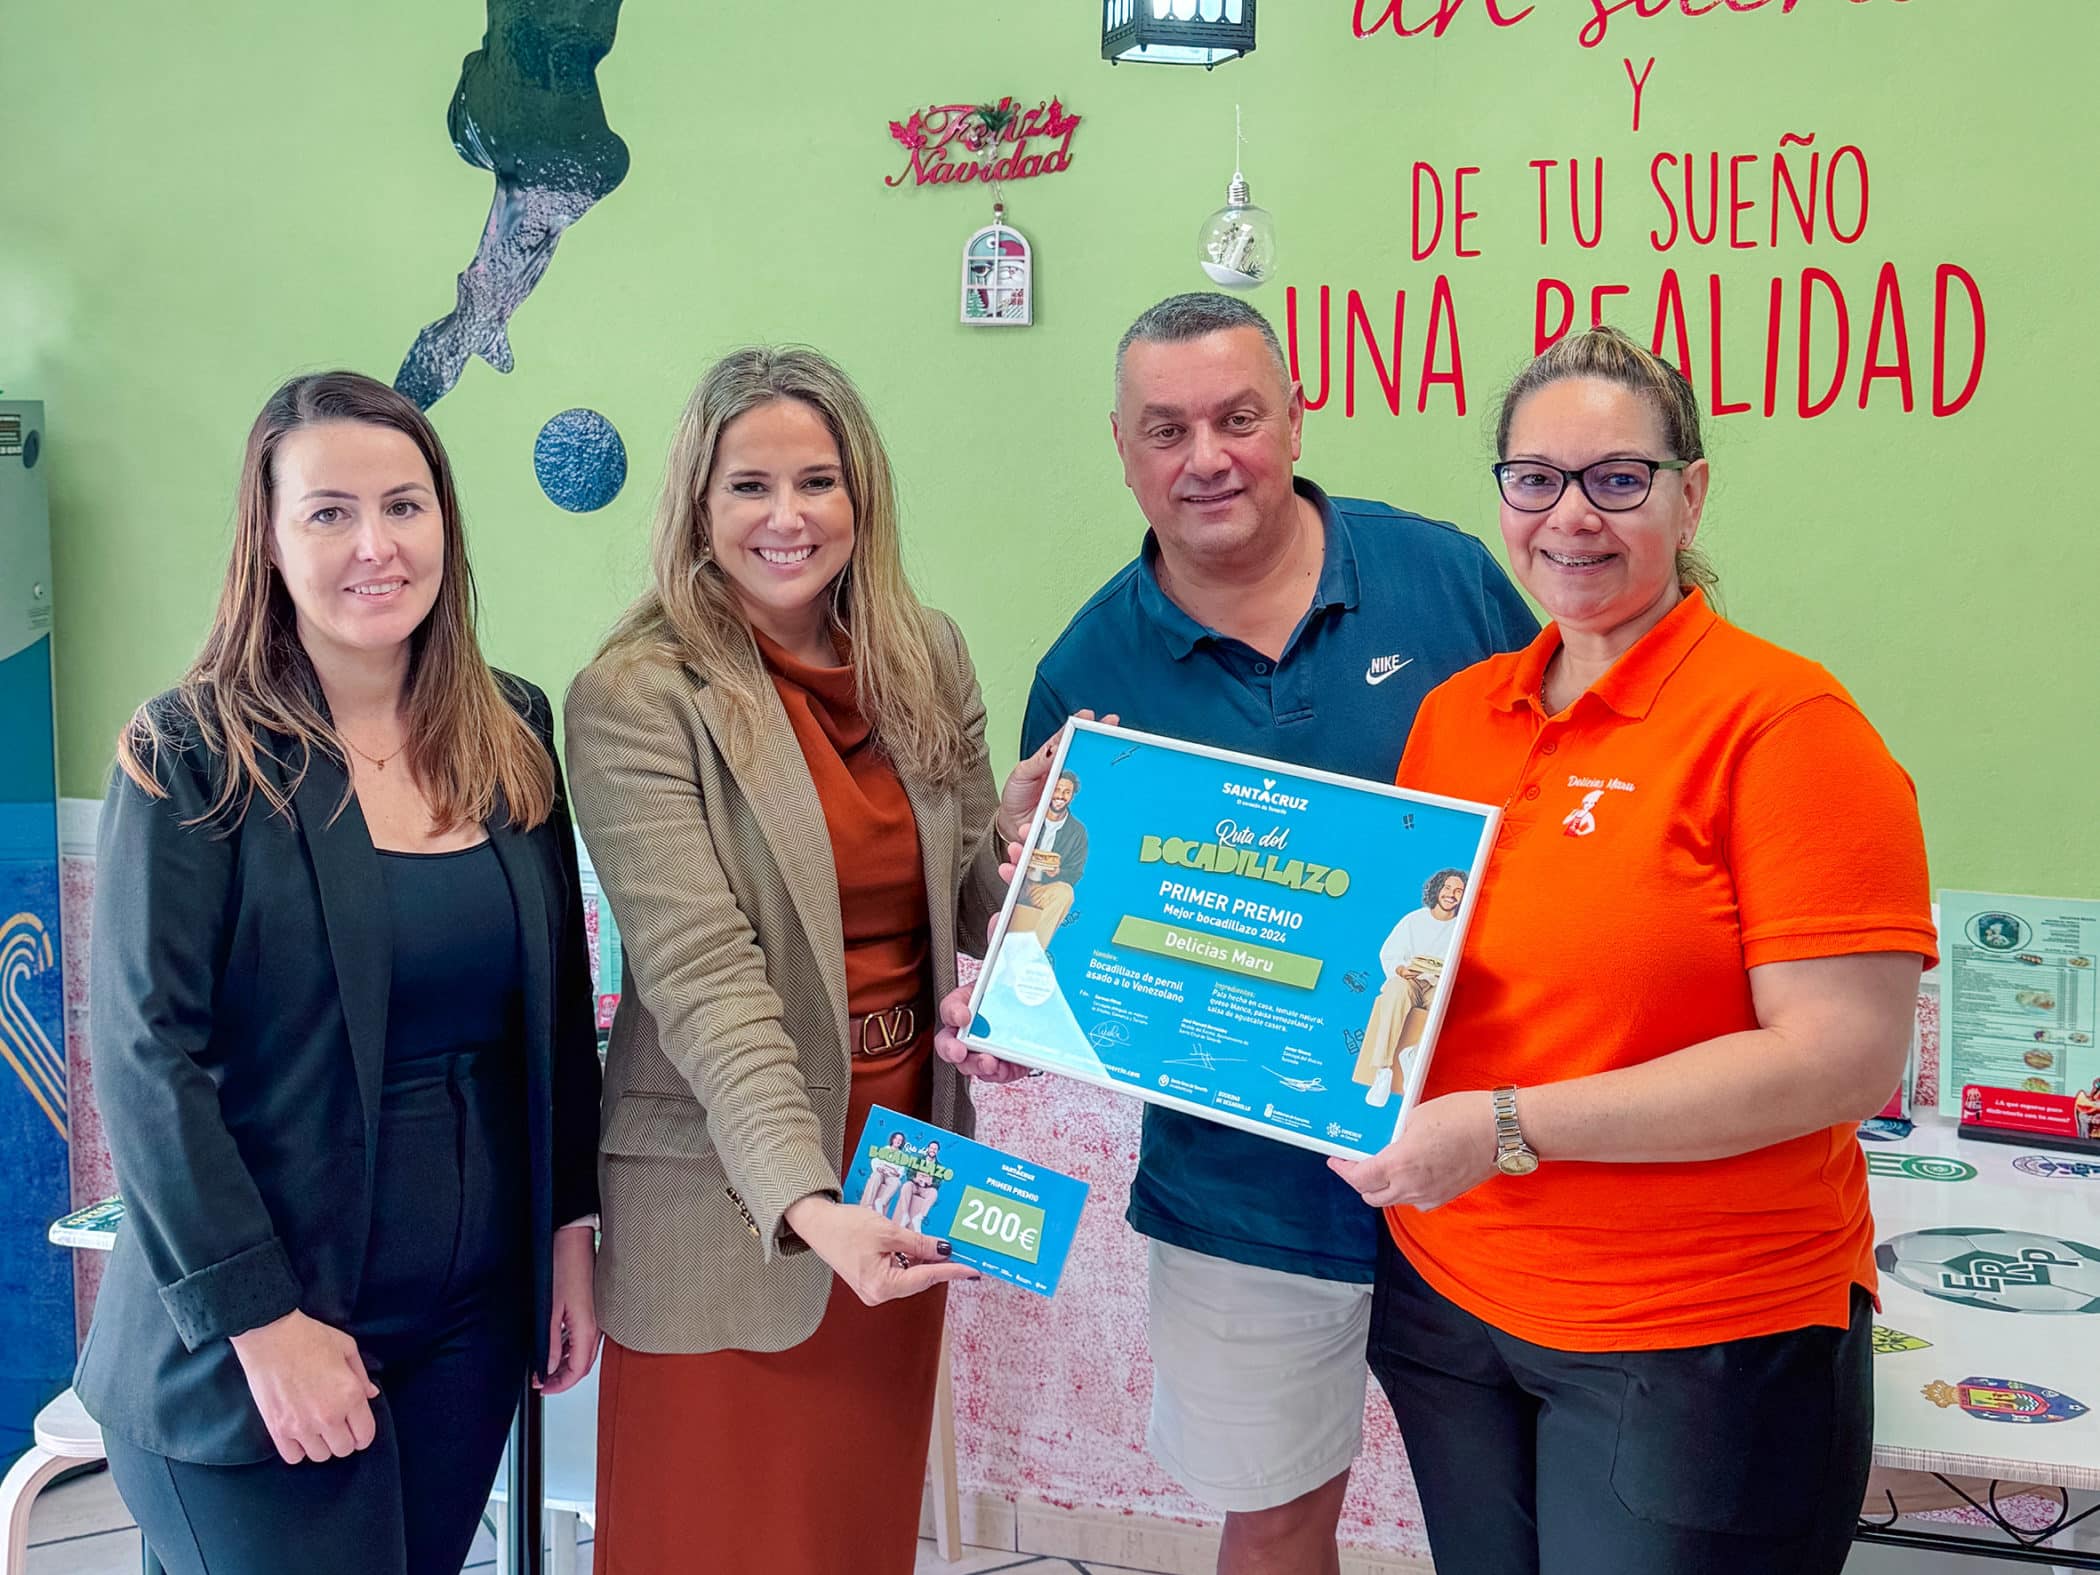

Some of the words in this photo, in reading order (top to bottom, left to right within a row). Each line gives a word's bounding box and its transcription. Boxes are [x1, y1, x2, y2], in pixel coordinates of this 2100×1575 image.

[1623, 57, 1655, 132] Y
[885, 126, 1074, 188] Navidad
[1411, 161, 1481, 262] DE
[1529, 156, 1603, 249] TU
[1650, 132, 1869, 252] SUEÑO
[1285, 275, 1467, 417] UNA
[1371, 654, 1401, 675] NIKE
[1216, 819, 1255, 847] Ruta
[1259, 826, 1290, 850] del
[1139, 835, 1350, 898] BOCADILLAZO
[1159, 880, 1229, 912] PRIMER
[1232, 899, 1303, 930] PREMIO
[1164, 903, 1196, 922] Mejor
[1196, 912, 1258, 937] bocadillazo
[1260, 927, 1287, 943] 2024
[1089, 958, 1141, 980] Bocadillazo
[1141, 972, 1154, 983] de
[1154, 979, 1184, 992] pernil
[1164, 931, 1228, 960] Delicias
[1231, 950, 1275, 973] Maru
[1085, 970, 1112, 984] asado
[1113, 978, 1120, 986] a
[1121, 977, 1130, 988] lo
[1132, 980, 1184, 1003] Venezolano
[962, 1199, 1038, 1252] 200€
